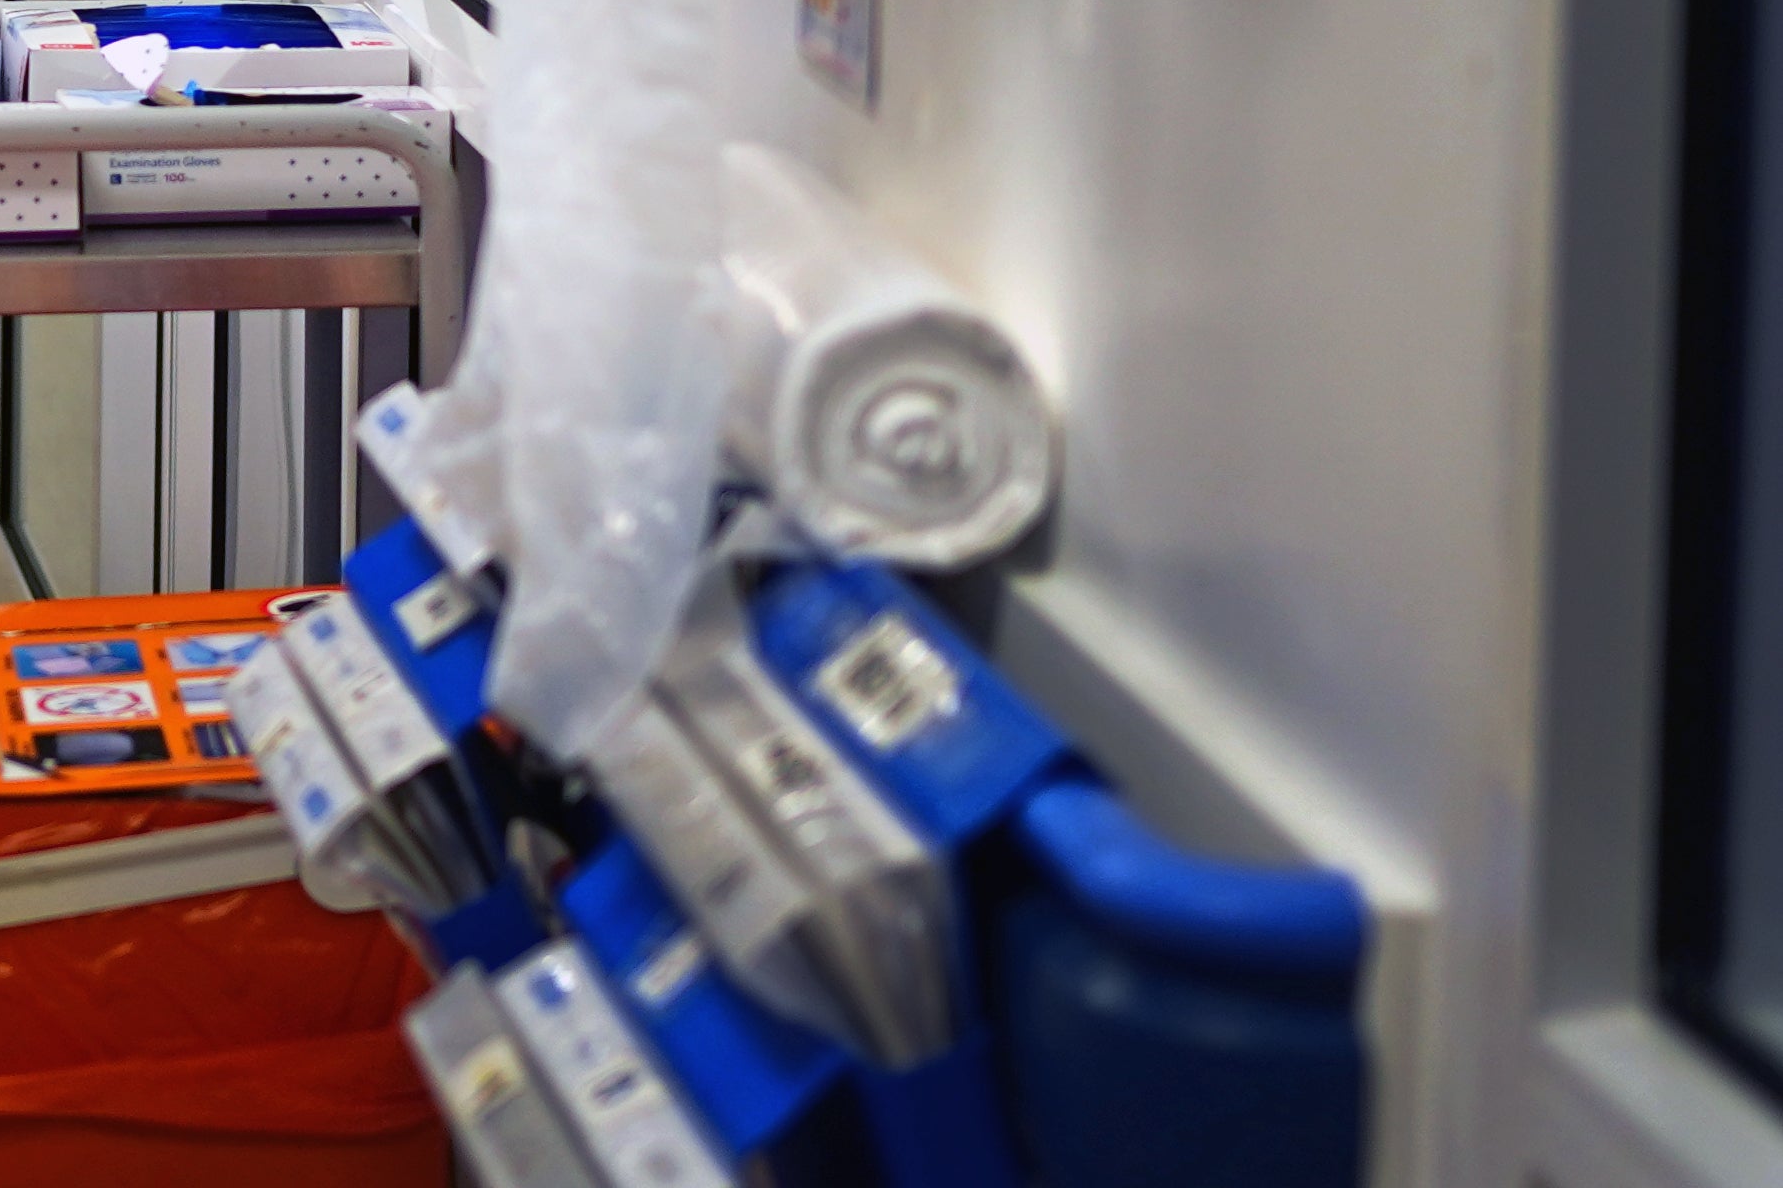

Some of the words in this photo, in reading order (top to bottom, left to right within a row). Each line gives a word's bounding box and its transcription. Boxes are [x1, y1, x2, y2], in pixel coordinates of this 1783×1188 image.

[109, 157, 181, 168] Examination
[182, 156, 221, 167] Gloves
[163, 172, 186, 183] 100
